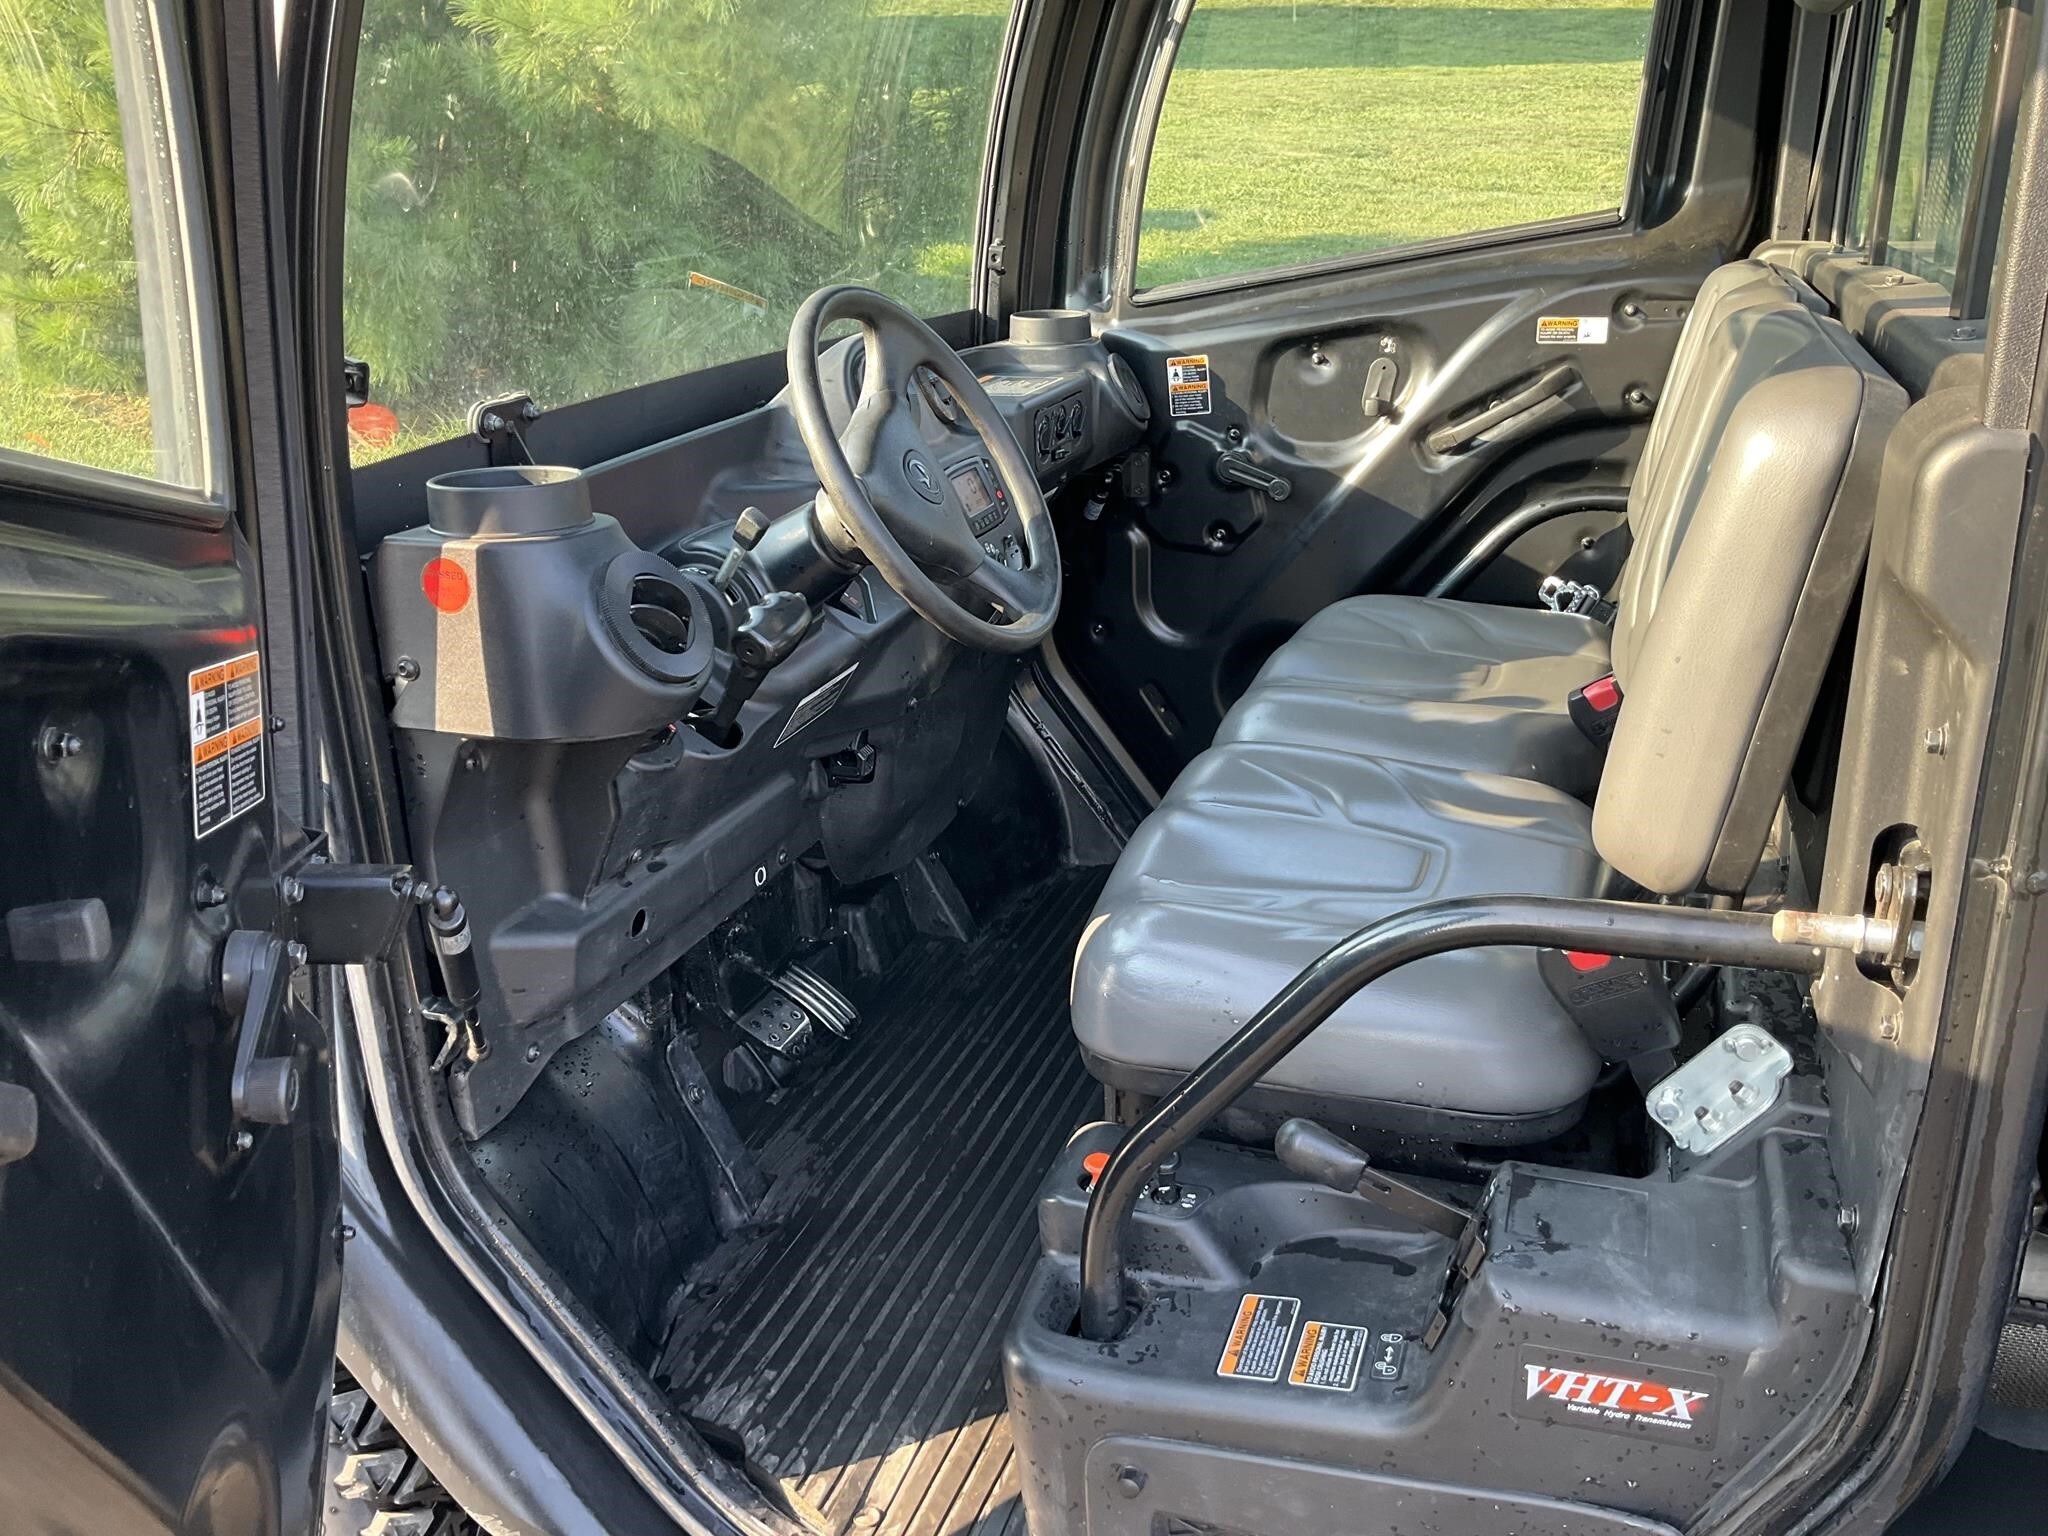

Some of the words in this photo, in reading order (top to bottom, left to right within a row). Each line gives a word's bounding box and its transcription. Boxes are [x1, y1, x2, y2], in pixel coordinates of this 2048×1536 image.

[1231, 1311, 1252, 1347] WARNING
[1296, 1329, 1317, 1368] WARNING
[1566, 1402, 1600, 1415] Variable
[1603, 1408, 1631, 1422] Hydro
[1634, 1413, 1692, 1430] Transmission
